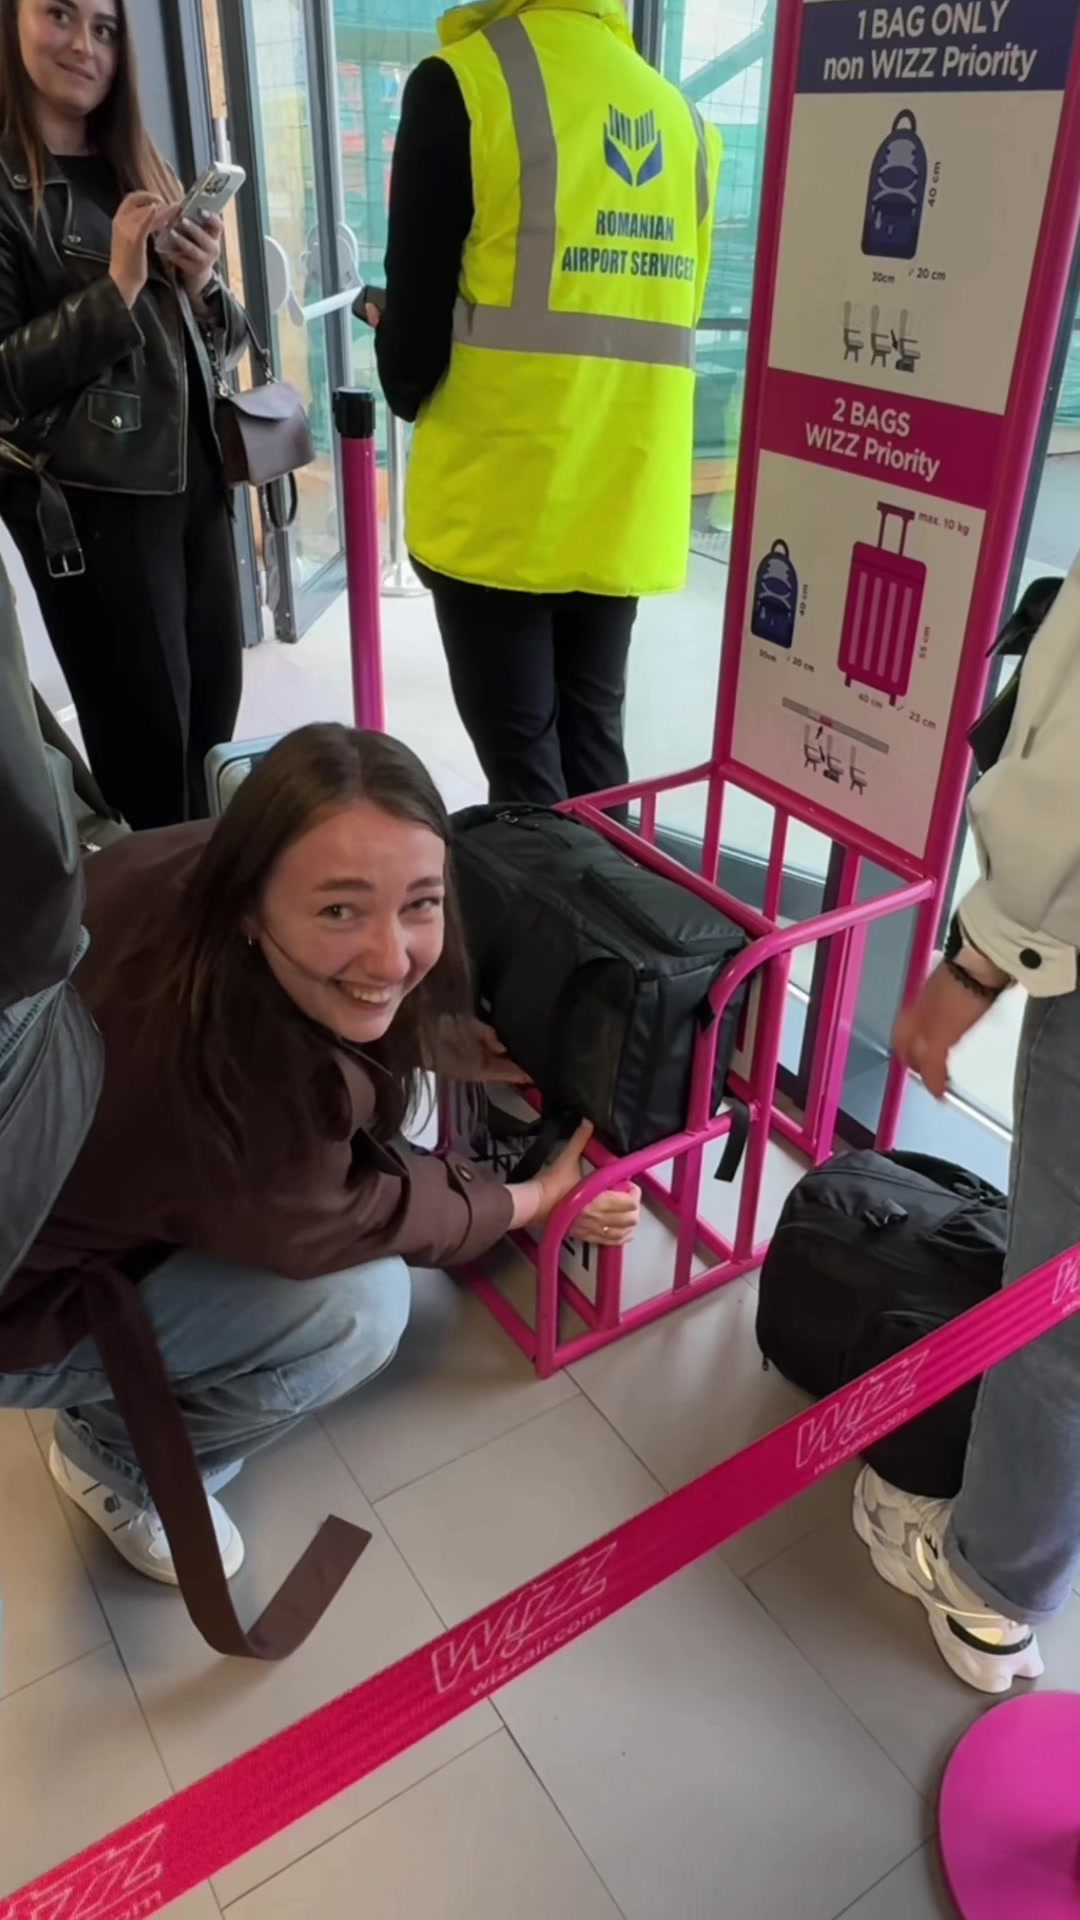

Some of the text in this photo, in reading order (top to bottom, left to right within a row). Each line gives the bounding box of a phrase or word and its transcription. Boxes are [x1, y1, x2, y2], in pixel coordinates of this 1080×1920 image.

[858, 0, 1010, 40] 1 BAG ONLY
[823, 42, 1038, 82] non WIZZ Priority
[928, 161, 941, 207] 40 cm
[596, 210, 674, 241] ROMANIAN
[562, 246, 629, 274] AIRPORT
[916, 267, 946, 281] 20 cm
[832, 398, 911, 437] 2 BAGS
[806, 422, 941, 482] WIZZ Priority
[918, 512, 970, 536] max. 10 kg
[923, 626, 930, 643] cm
[803, 662, 815, 672] cm
[870, 698, 883, 709] cm
[922, 718, 936, 730] cm
[470, 1607, 601, 1696] wizzair.com
